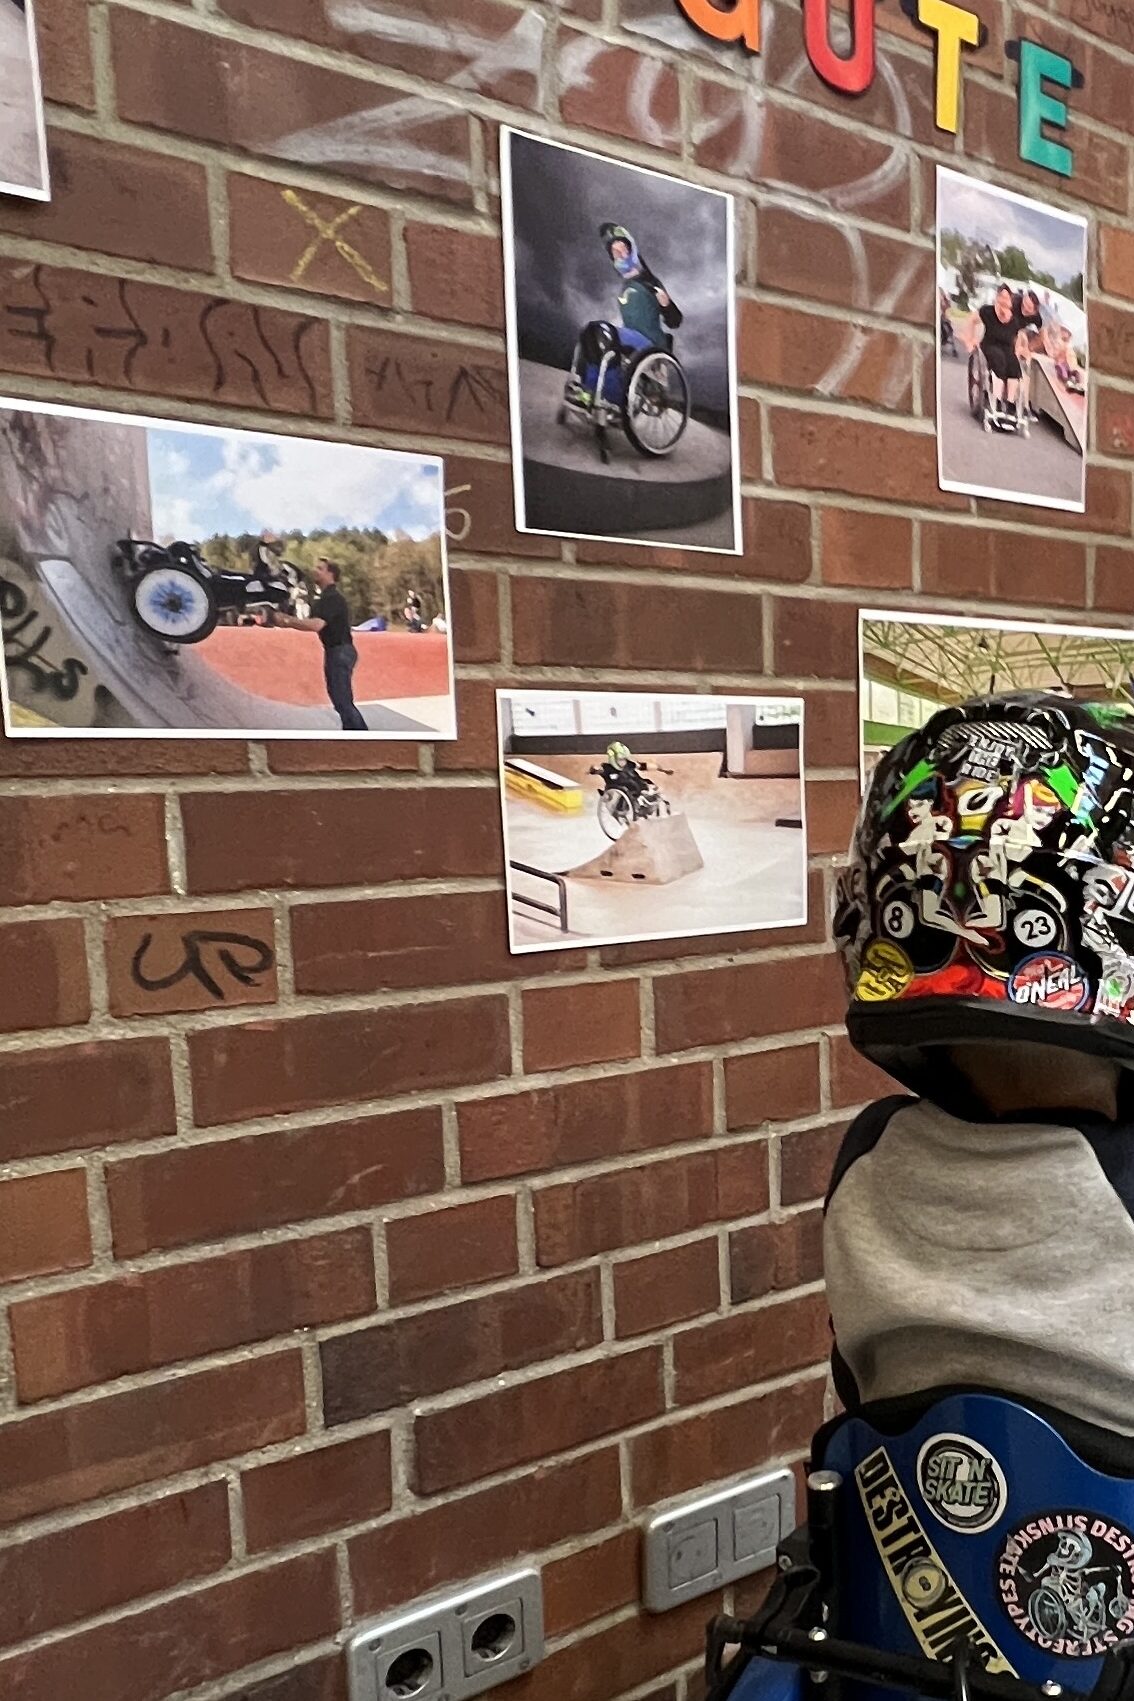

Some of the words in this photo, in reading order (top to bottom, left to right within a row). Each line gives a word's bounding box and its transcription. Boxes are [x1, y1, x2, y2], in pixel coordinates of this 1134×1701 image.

[888, 905, 904, 932] 8
[1020, 915, 1051, 941] 23
[928, 1456, 962, 1481] SIT
[925, 1480, 993, 1506] SKATE
